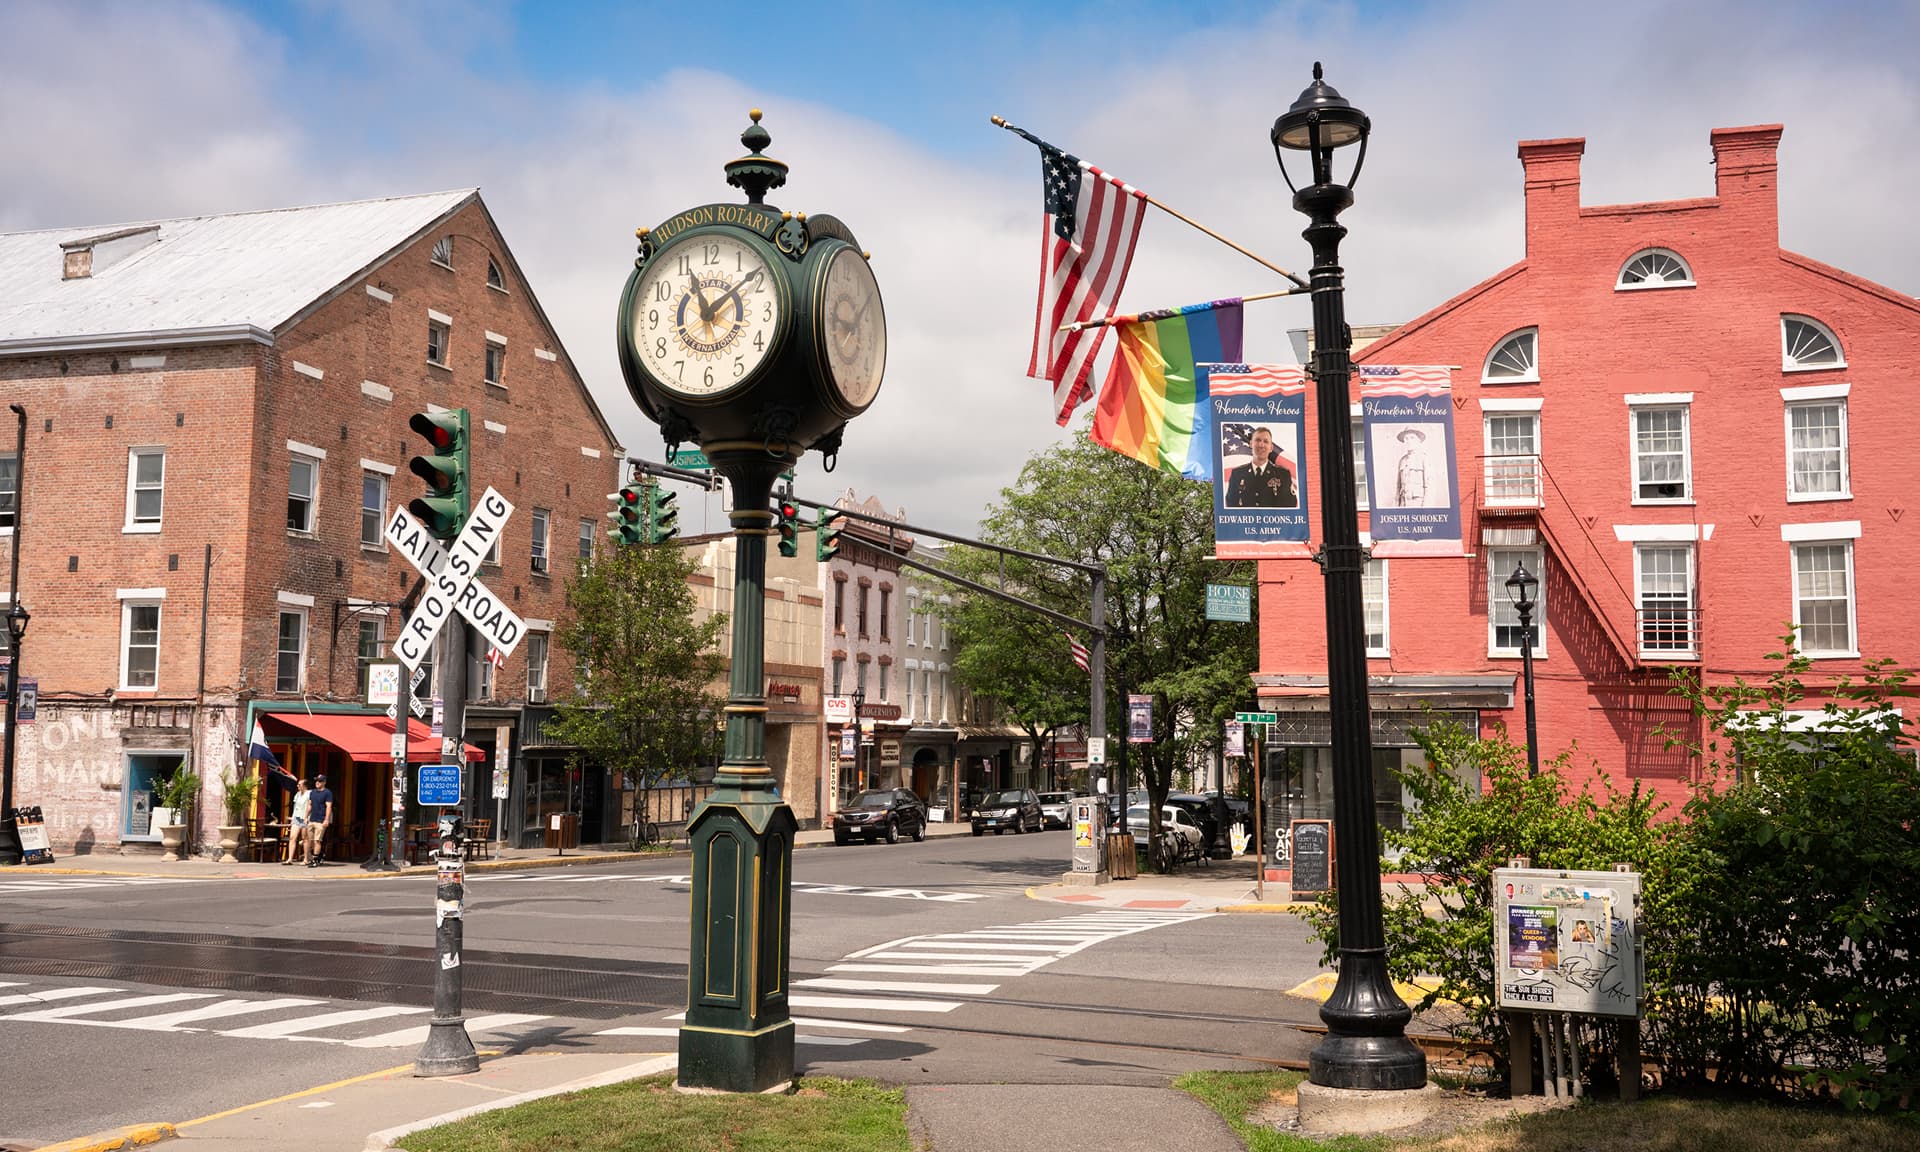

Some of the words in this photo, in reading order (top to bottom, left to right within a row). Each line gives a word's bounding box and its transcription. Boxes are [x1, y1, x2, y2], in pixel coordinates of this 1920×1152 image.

[656, 207, 713, 243] HUDSON
[717, 206, 774, 233] ROTARY
[703, 244, 720, 265] 12
[736, 251, 743, 272] 1
[678, 255, 690, 276] 11
[655, 280, 671, 302] 10
[699, 280, 729, 290] OTARY
[754, 271, 764, 293] 2
[649, 309, 659, 331] 9
[763, 301, 772, 322] 3
[655, 336, 667, 359] 8
[753, 329, 765, 352] 4
[673, 360, 685, 382] 7
[733, 353, 745, 378] 5
[703, 366, 714, 388] 6
[1214, 399, 1266, 416] Hometown
[1267, 399, 1300, 416] Heroes
[1365, 400, 1415, 417] Hometown
[1415, 400, 1448, 416] Heroes
[1219, 515, 1255, 524] EDWARD
[1263, 515, 1293, 525] COONS,
[1294, 515, 1307, 525] JR.
[1380, 514, 1410, 524] JOSEPH
[1411, 514, 1449, 523] SOROKEY
[1244, 527, 1258, 535] U.S.
[1259, 527, 1281, 535] ARMY
[1397, 526, 1411, 534] U.S.
[1411, 526, 1434, 534] ARMY
[390, 513, 440, 577] RAIL
[458, 582, 517, 645] ROAD
[401, 496, 506, 660] CROSSING
[1208, 585, 1250, 599] HOUSE
[827, 700, 847, 709] CVS
[42, 710, 120, 751] ONE
